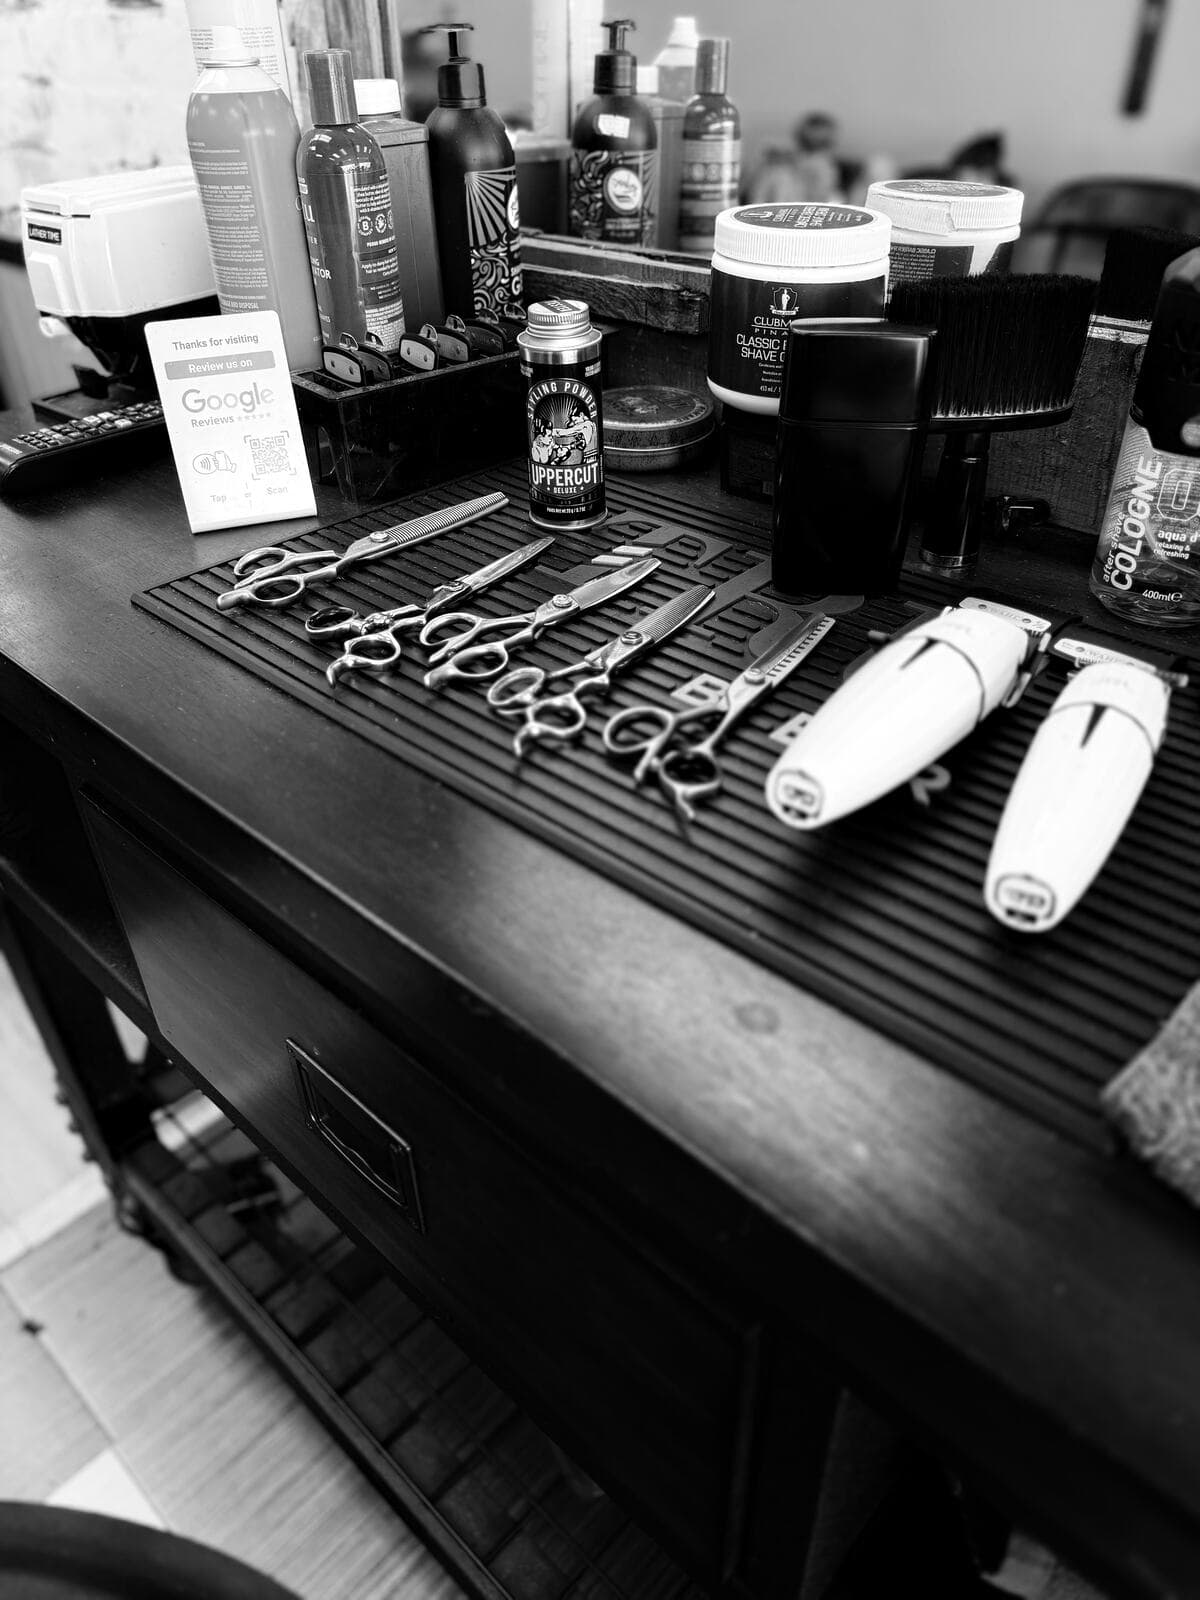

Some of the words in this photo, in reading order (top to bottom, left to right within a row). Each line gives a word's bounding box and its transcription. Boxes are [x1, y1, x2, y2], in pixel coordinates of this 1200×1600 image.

[753, 316, 792, 328] CLUBM
[754, 328, 789, 336] PINA
[171, 339, 208, 351] Thanks
[209, 337, 223, 347] for
[225, 333, 259, 344] visiting
[736, 333, 781, 350] CLASSIC
[741, 346, 777, 362] SHAVE
[188, 361, 224, 374] Review
[226, 360, 239, 370] us
[240, 359, 253, 369] on
[182, 381, 274, 413] Google
[528, 382, 558, 420] STYLING
[564, 382, 598, 419] POWDER
[191, 415, 235, 428] Reviews
[531, 462, 599, 487] UPPERCUT
[266, 486, 289, 496] Scan
[553, 486, 577, 494] DELUXE
[209, 494, 227, 504] Tap
[1110, 455, 1162, 591] COLOGNE
[1157, 530, 1187, 542] aqua
[1102, 550, 1115, 582] after
[1110, 512, 1127, 549] shave
